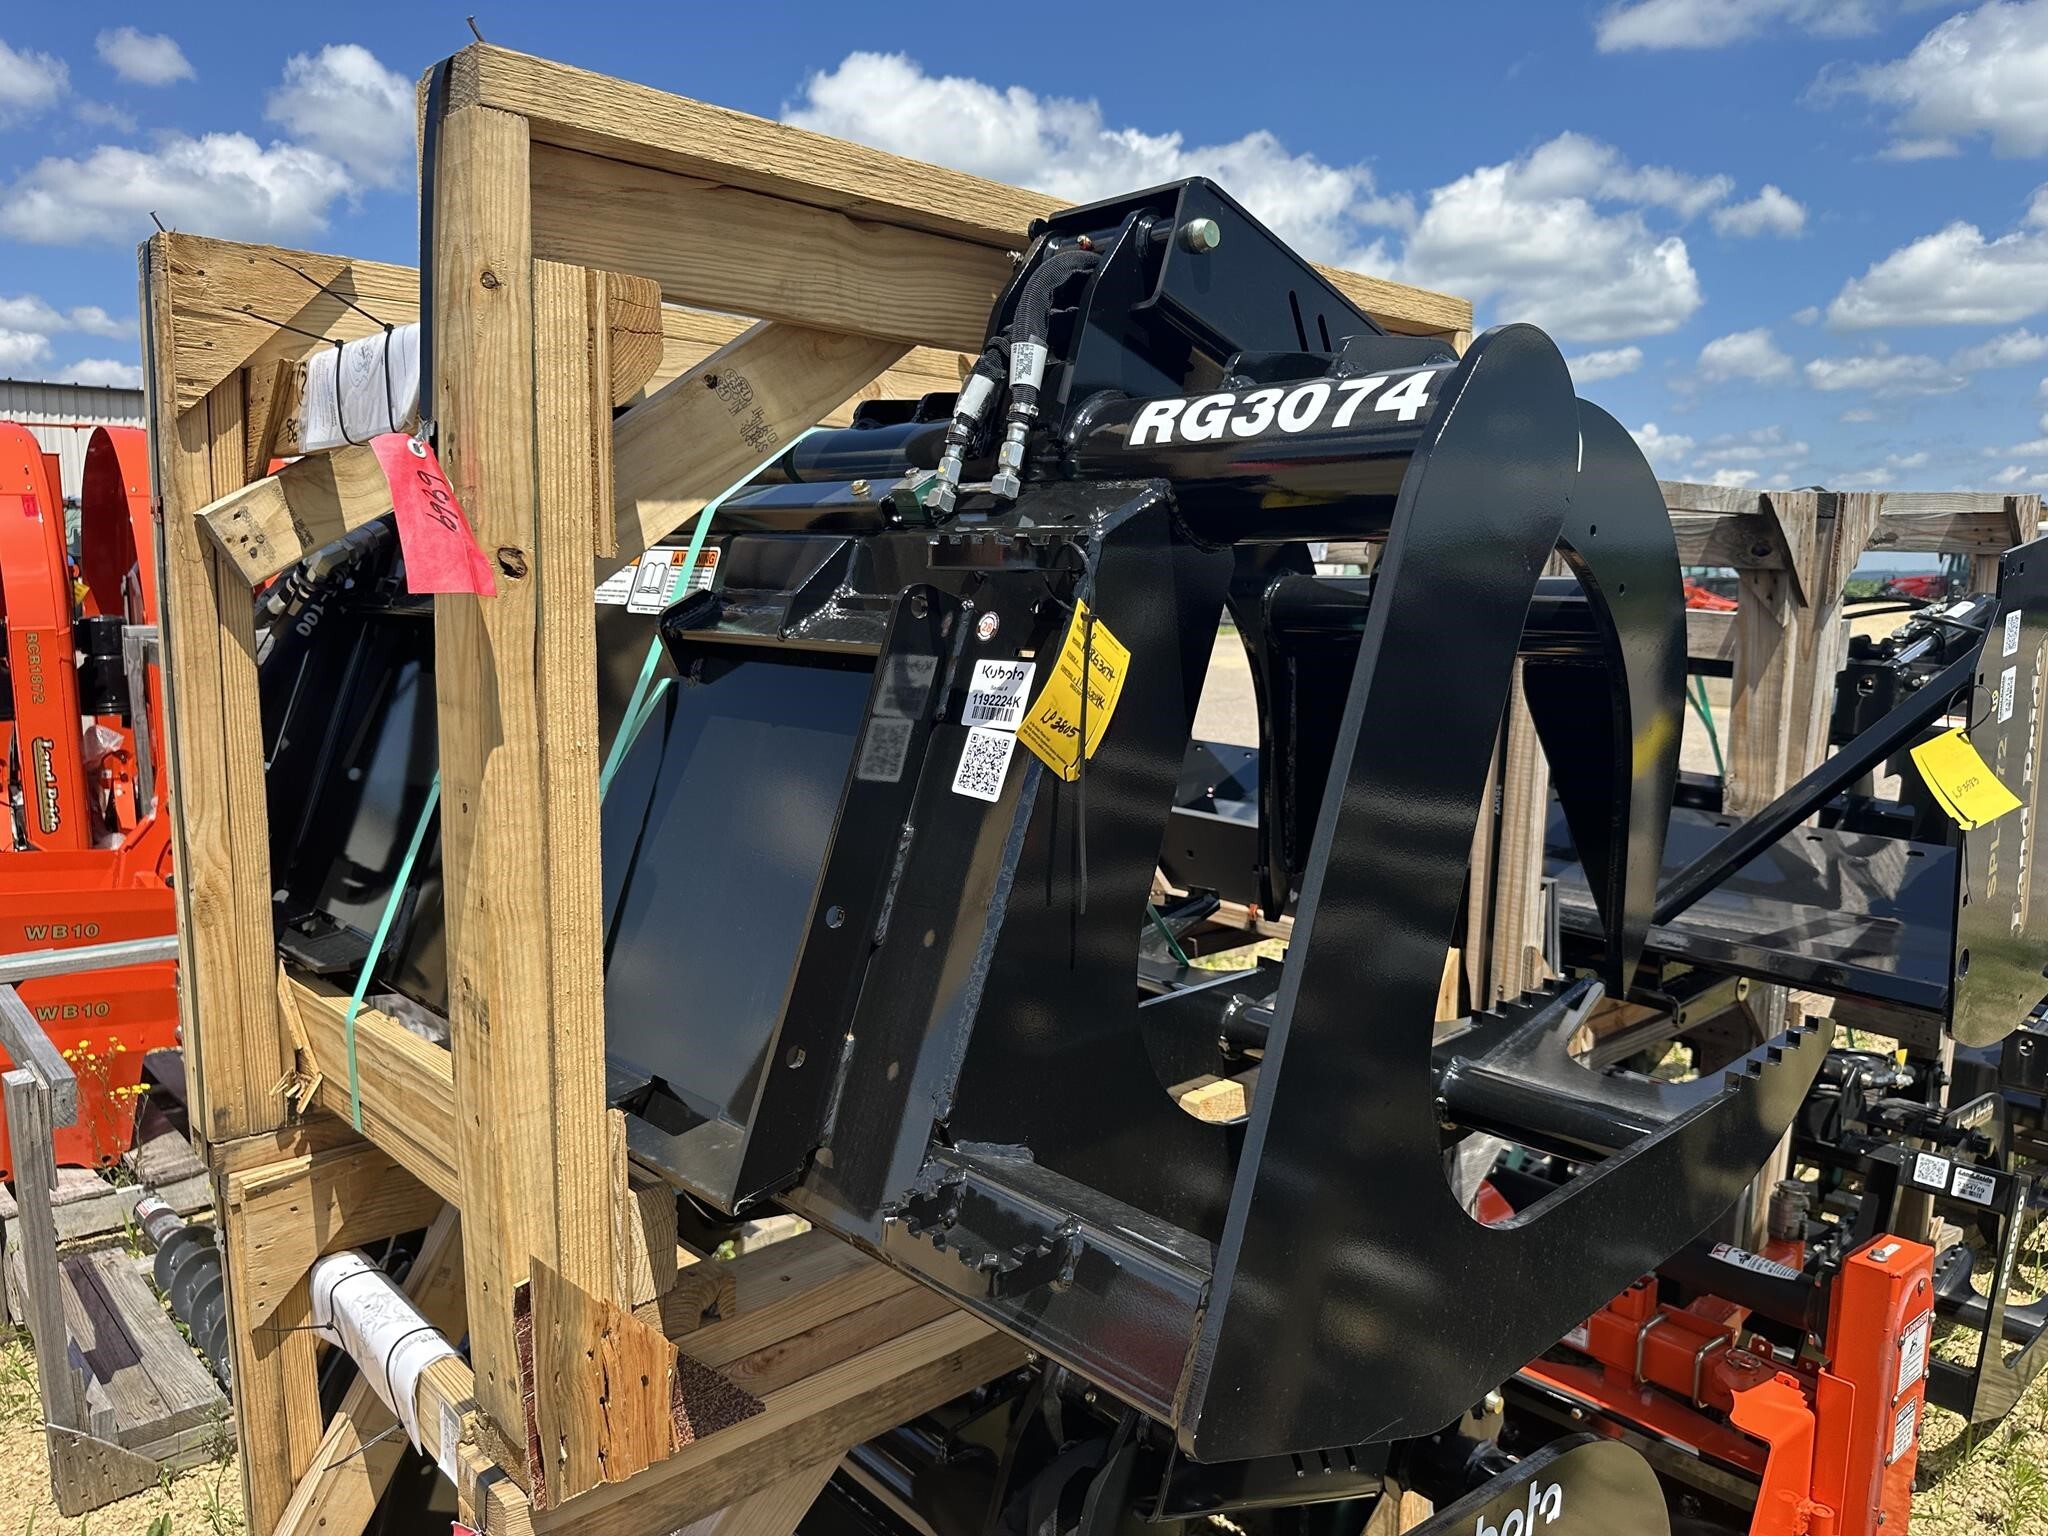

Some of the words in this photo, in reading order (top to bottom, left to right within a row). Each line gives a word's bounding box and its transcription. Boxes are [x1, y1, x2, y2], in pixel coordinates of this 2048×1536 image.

[1129, 370, 1437, 446] RG3074
[26, 632, 45, 704] RCR1872
[982, 665, 1024, 680] Kubota
[973, 693, 1021, 708] 1192224K
[42, 738, 56, 782] Land
[47, 786, 61, 832] Pride
[2011, 806, 2031, 933] Land
[2022, 645, 2043, 787] Pride
[24, 923, 101, 941] WB10
[36, 1001, 111, 1022] WB10
